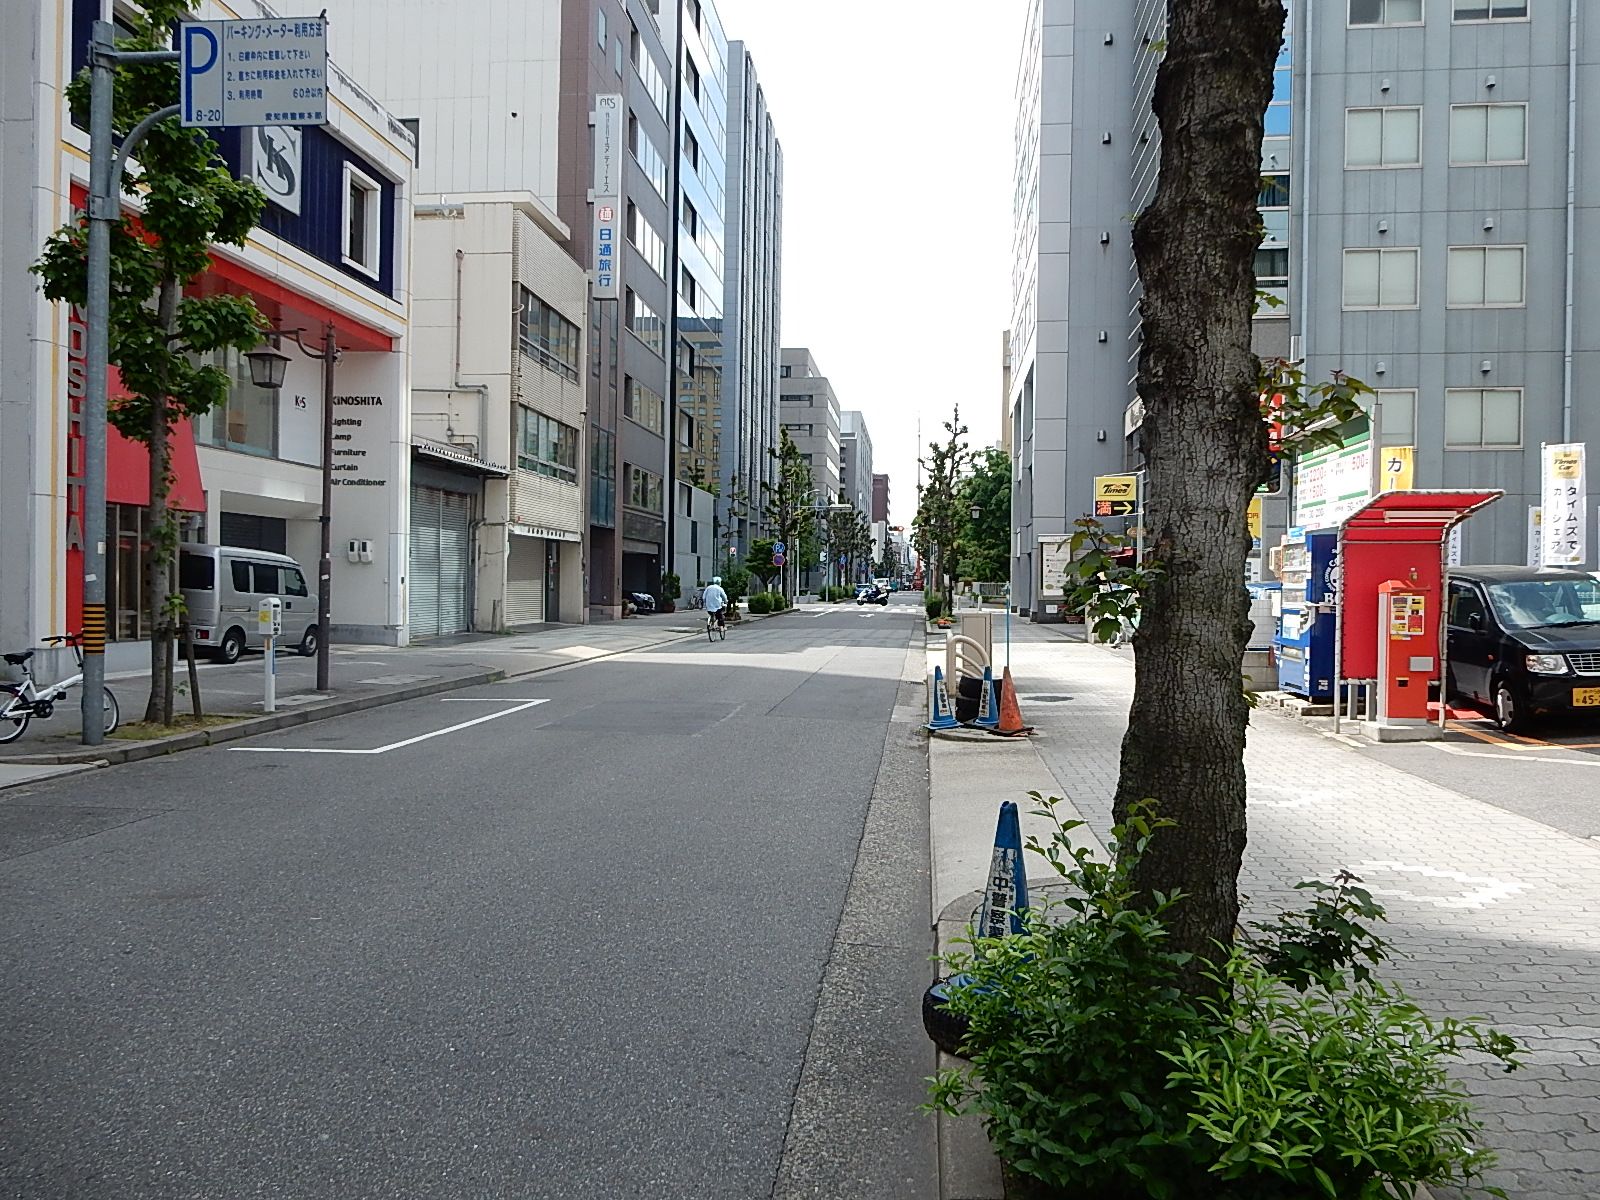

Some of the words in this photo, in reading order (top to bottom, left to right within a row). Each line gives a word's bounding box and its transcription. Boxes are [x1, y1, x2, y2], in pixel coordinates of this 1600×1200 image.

[185, 26, 218, 122] P
[196, 109, 221, 122] 8-20
[599, 228, 612, 287] 日通旅行
[342, 478, 386, 486] Conditioner
[1103, 483, 1131, 495] Times
[1097, 501, 1111, 515] 満
[1551, 488, 1561, 549] カーシェア
[1566, 487, 1578, 550] タイムズで
